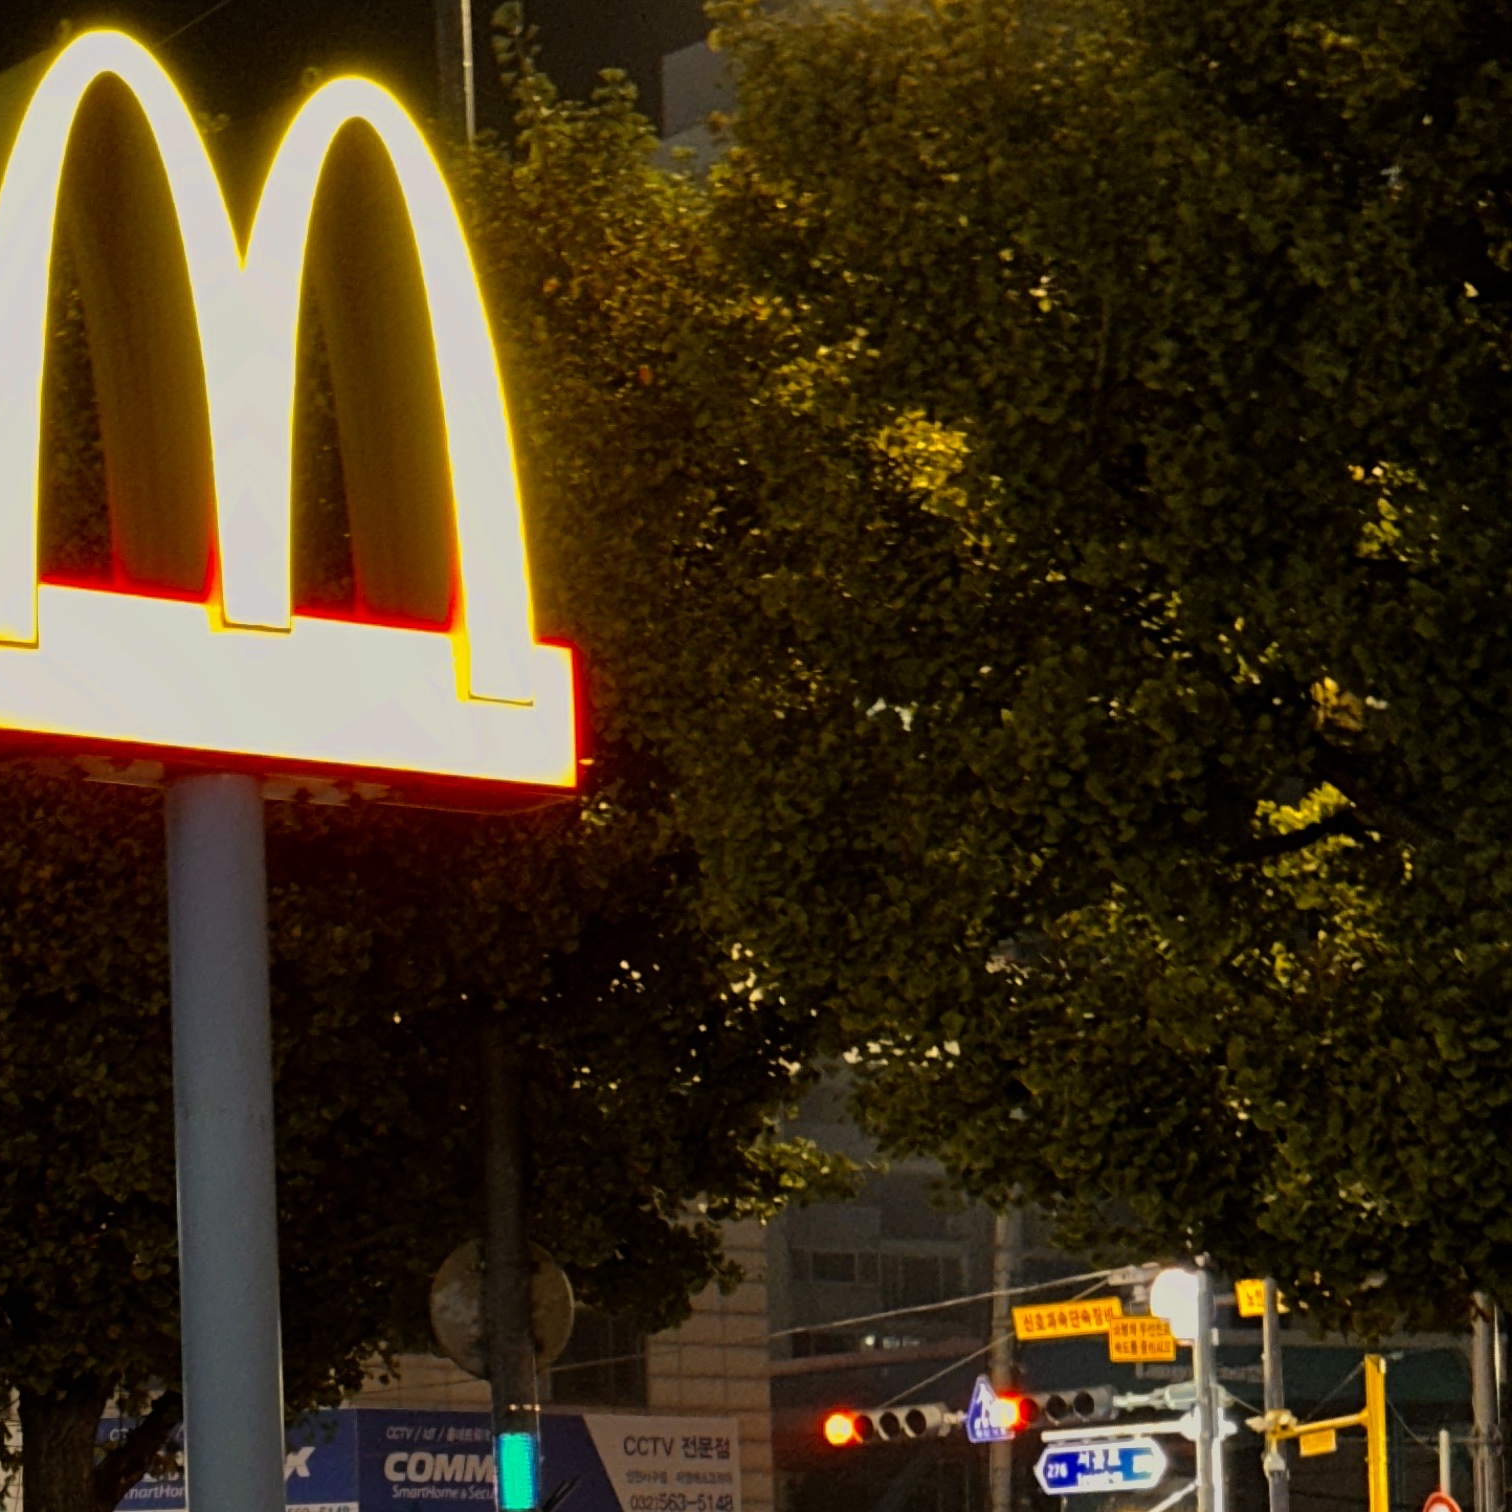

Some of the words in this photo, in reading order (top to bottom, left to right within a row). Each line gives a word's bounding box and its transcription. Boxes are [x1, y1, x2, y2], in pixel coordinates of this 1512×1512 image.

[623, 1435, 674, 1456] CCTV
[681, 1434, 730, 1460] 전문점
[384, 1452, 495, 1483] COMM
